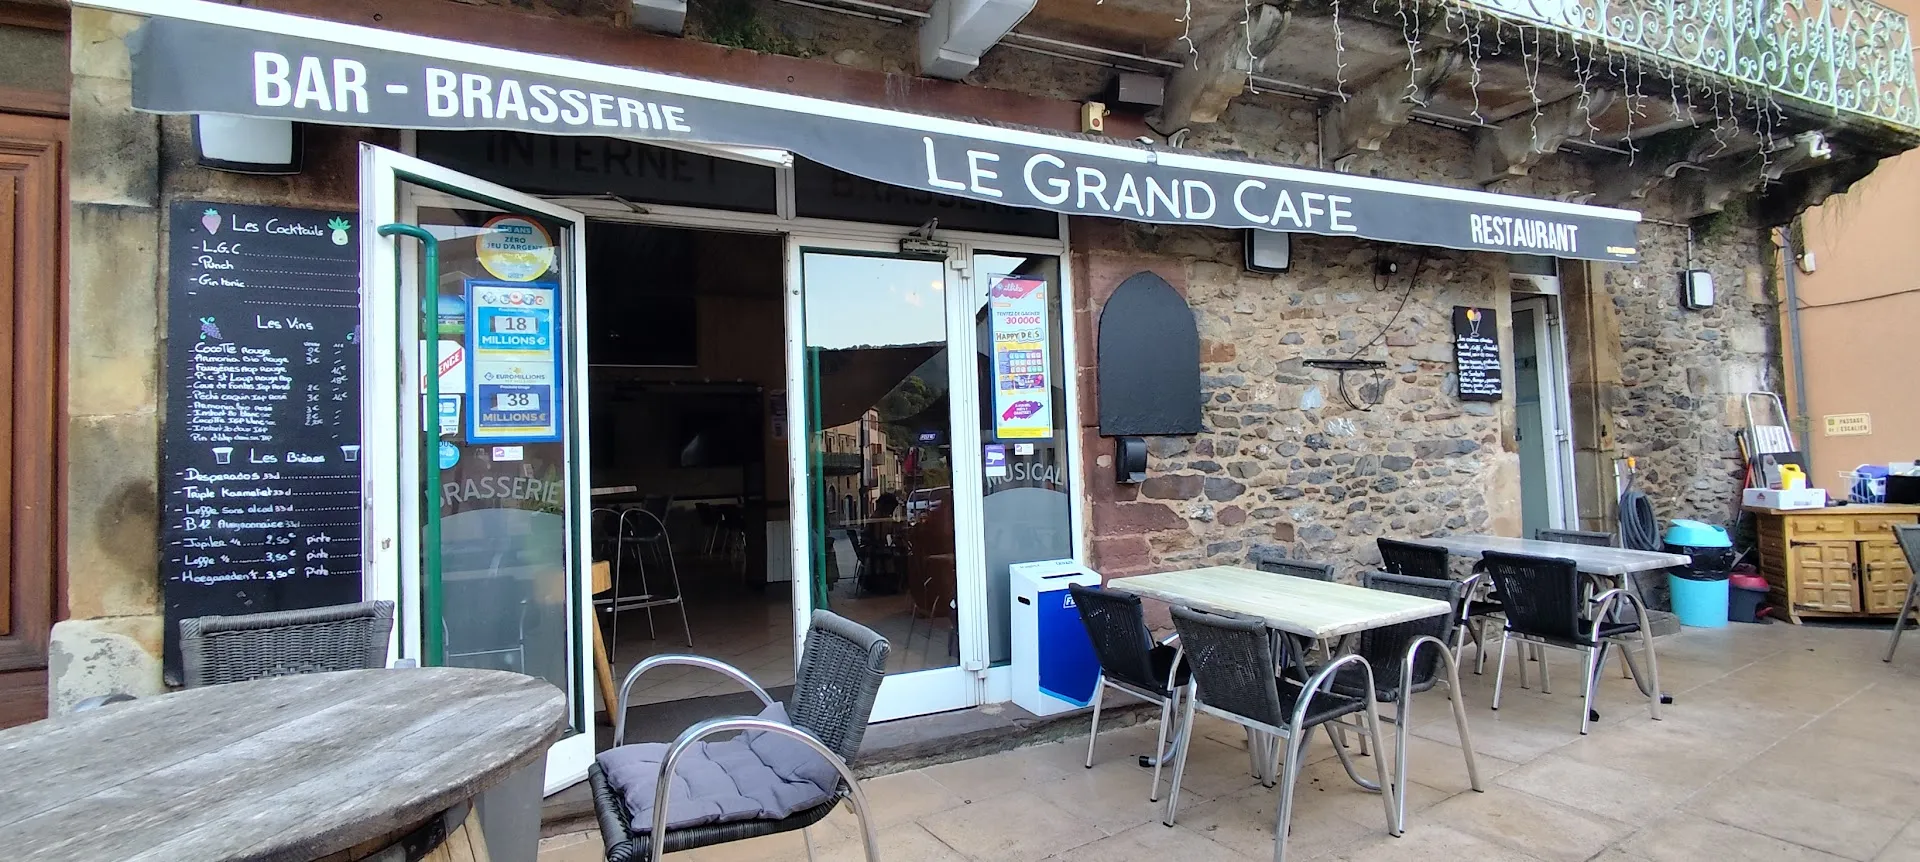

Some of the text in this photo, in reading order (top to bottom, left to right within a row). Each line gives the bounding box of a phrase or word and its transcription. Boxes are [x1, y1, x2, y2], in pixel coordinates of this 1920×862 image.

[253, 50, 370, 114] BAR
[424, 66, 691, 133] BRASSERIE
[922, 136, 1358, 233] LE GRAND CAFE
[232, 214, 324, 237] Les Cocktails
[504, 236, 526, 244] ZÉRO
[1470, 213, 1578, 253] RESTAURANT
[198, 255, 234, 270] Punch
[198, 274, 246, 288] Gin tonic
[257, 315, 314, 331] Les Vins
[505, 317, 527, 331] 18
[482, 335, 547, 345] MILLIONS €
[996, 332, 1019, 341] HAPPY
[241, 347, 271, 358] Rouge
[263, 356, 290, 366] Rouge
[259, 366, 288, 375] Rouge
[216, 381, 227, 389] de
[229, 373, 254, 383] Loup
[507, 393, 530, 407] 38
[482, 413, 546, 422] MILLIONS €
[250, 448, 326, 464] Les Bières
[183, 467, 260, 483] Desperados
[182, 486, 216, 500] Triple
[425, 476, 564, 508] RASSERIE
[185, 504, 219, 518] Leffe
[183, 535, 228, 550] Jupiler
[306, 532, 331, 545] pinte
[184, 554, 216, 568] Leffe
[306, 549, 329, 562] pinte
[182, 570, 249, 586] Hoegaarden
